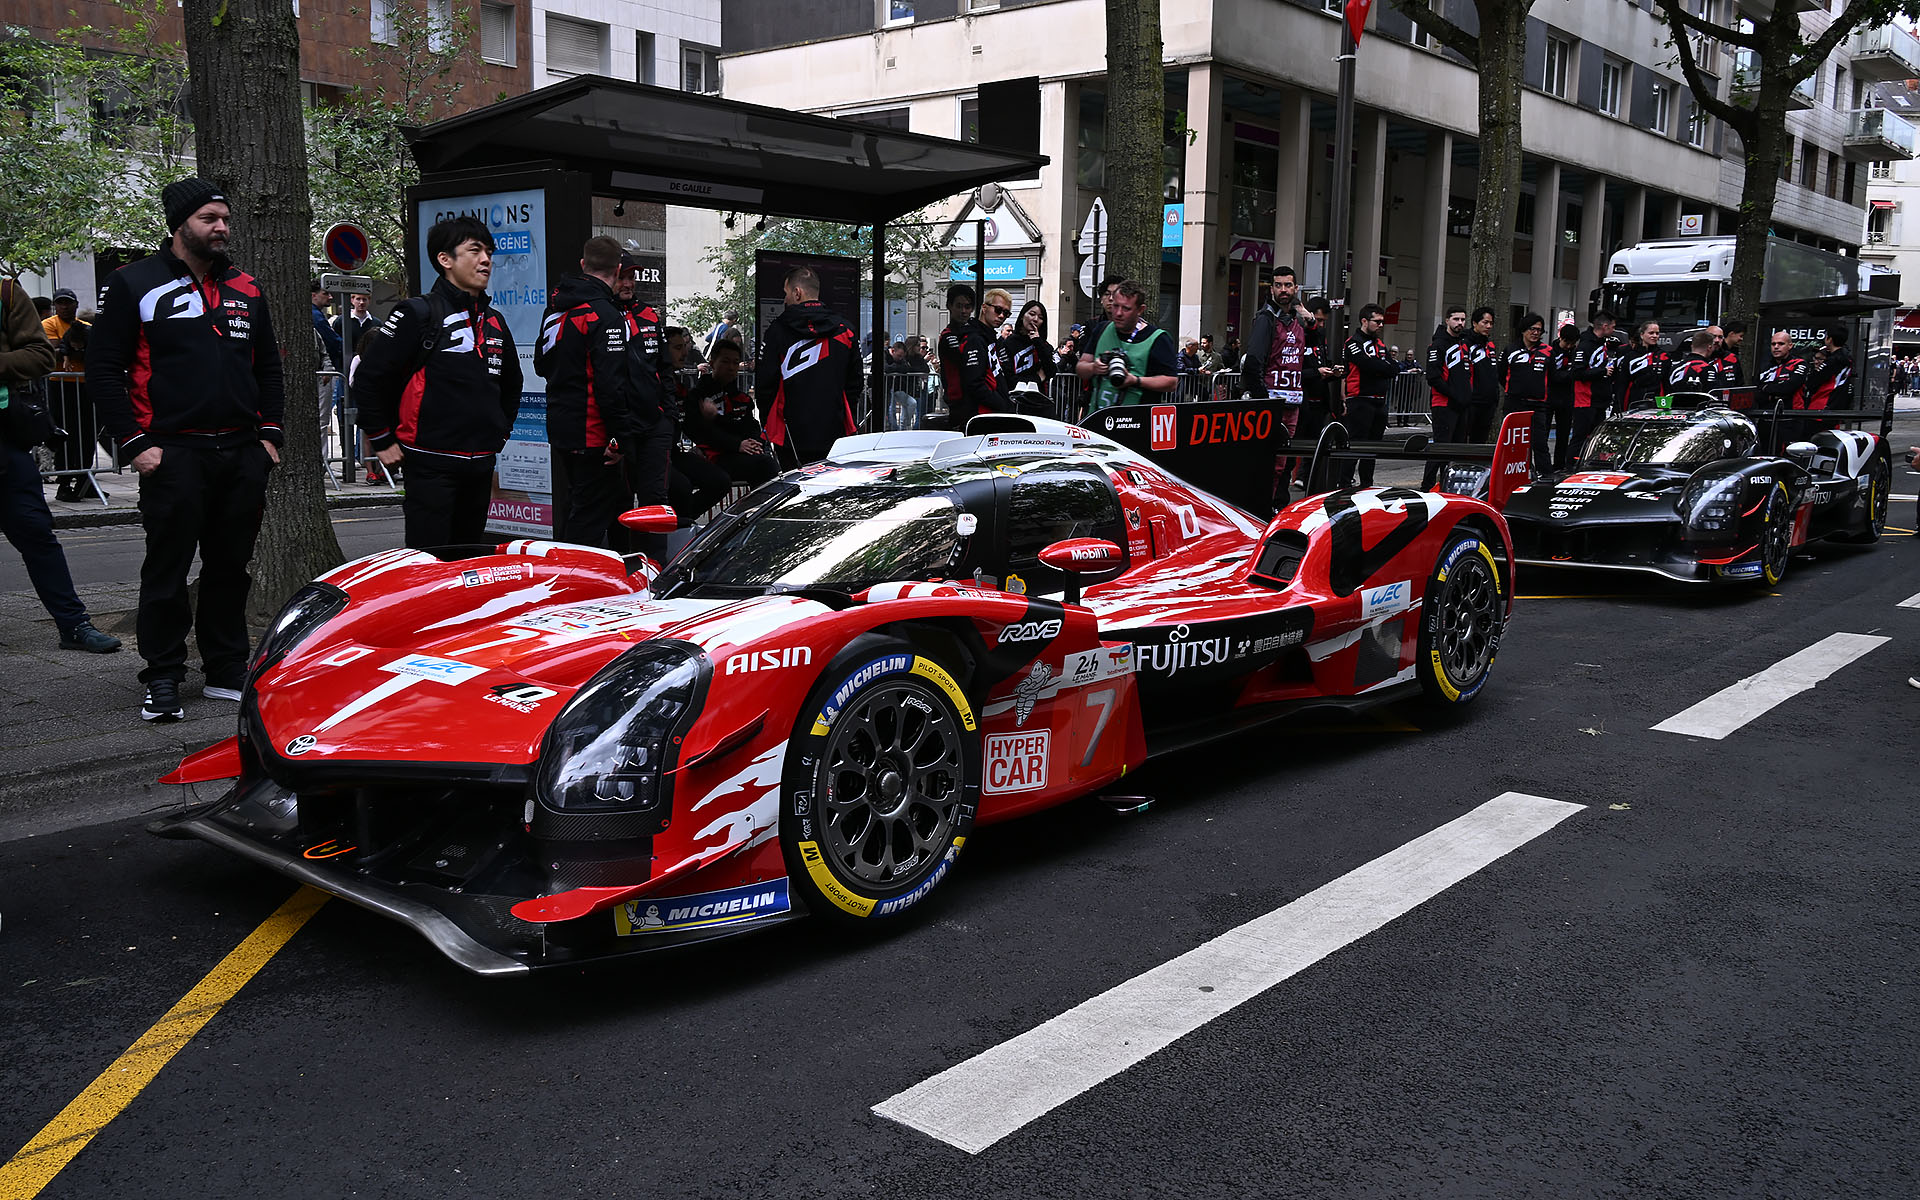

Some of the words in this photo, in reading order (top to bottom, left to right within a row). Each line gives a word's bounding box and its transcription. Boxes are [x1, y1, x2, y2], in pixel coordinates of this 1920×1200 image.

[669, 182, 680, 190] DE
[682, 184, 712, 194] GAULLE
[1816, 329, 1826, 340] 5
[1282, 356, 1300, 364] TRACK
[1153, 414, 1174, 443] HY
[1189, 409, 1272, 446] DENSO
[1504, 426, 1530, 445] JFE
[1582, 475, 1609, 483] 8
[1751, 476, 1772, 485] AISIN
[1556, 488, 1600, 496] FUJITSU
[1071, 549, 1100, 560] Mobil
[1448, 540, 1477, 565] MICHELIN
[466, 573, 493, 586] GR
[494, 575, 523, 583] Racing
[1370, 583, 1404, 606] WEC
[997, 619, 1063, 643] RAYS
[444, 627, 542, 657] 7
[406, 658, 474, 674] WEC
[725, 646, 812, 676] AISIN
[1135, 637, 1231, 678] FUJITSU
[835, 657, 906, 708] MICHELIN
[918, 662, 938, 676] PILOT
[937, 673, 957, 693] SPORT
[482, 694, 502, 703] LE
[963, 712, 973, 726] M
[1080, 688, 1116, 767] 7
[990, 736, 1045, 759] HYPER
[989, 754, 1043, 788] CAR
[803, 846, 819, 862] M
[825, 882, 848, 903] SPORT
[880, 862, 947, 914] MICHELIN
[668, 891, 776, 921] MICHELIN
[847, 898, 868, 912] PILOT
